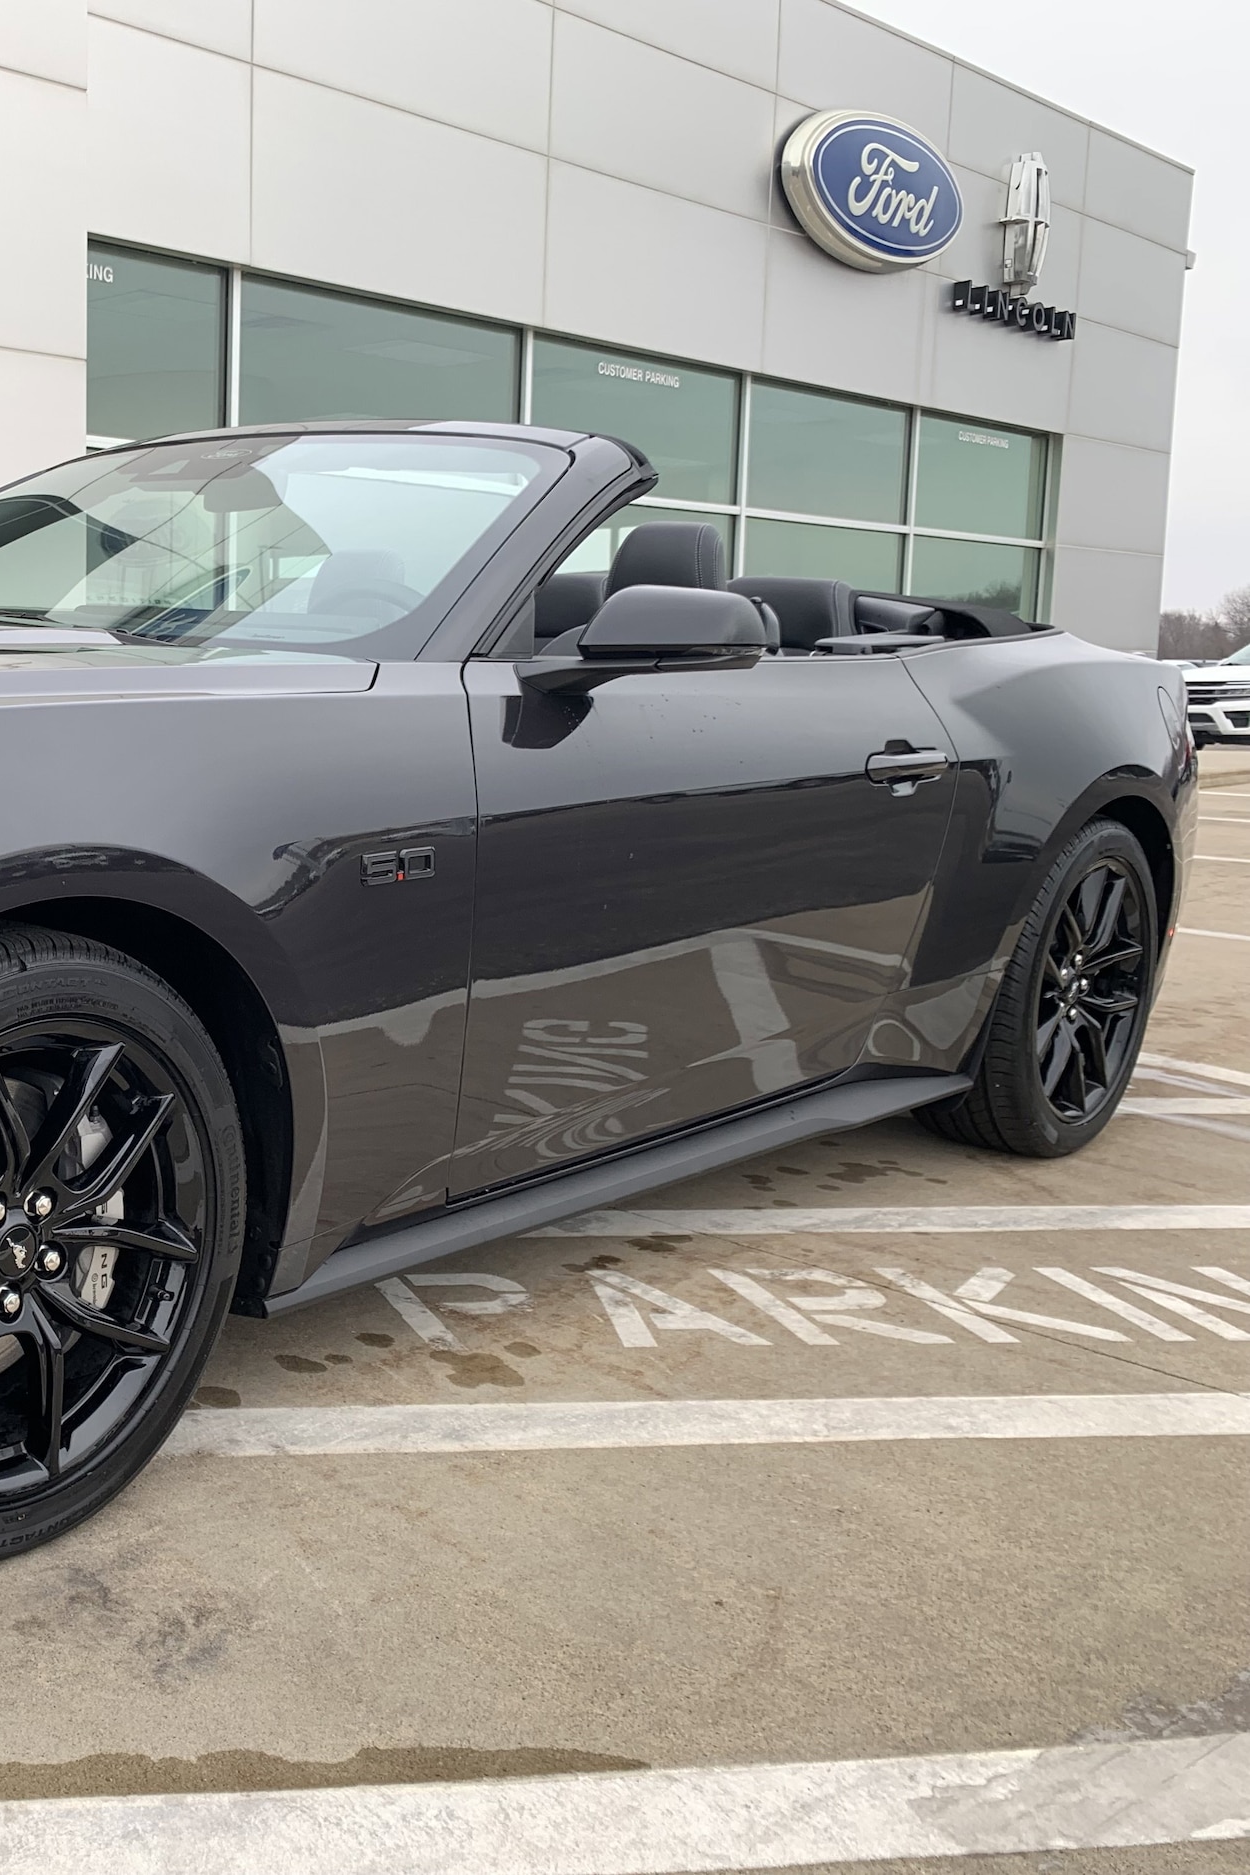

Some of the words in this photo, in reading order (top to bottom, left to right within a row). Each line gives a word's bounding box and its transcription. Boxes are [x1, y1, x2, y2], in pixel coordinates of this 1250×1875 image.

[847, 142, 939, 238] Ford
[953, 279, 1077, 341] LINCOLN
[598, 362, 644, 382] CUSTOMER
[645, 371, 680, 388] PARKING
[957, 430, 987, 445] CUSTOMER
[987, 436, 1010, 449] PARKING
[361, 846, 436, 887] 5.0
